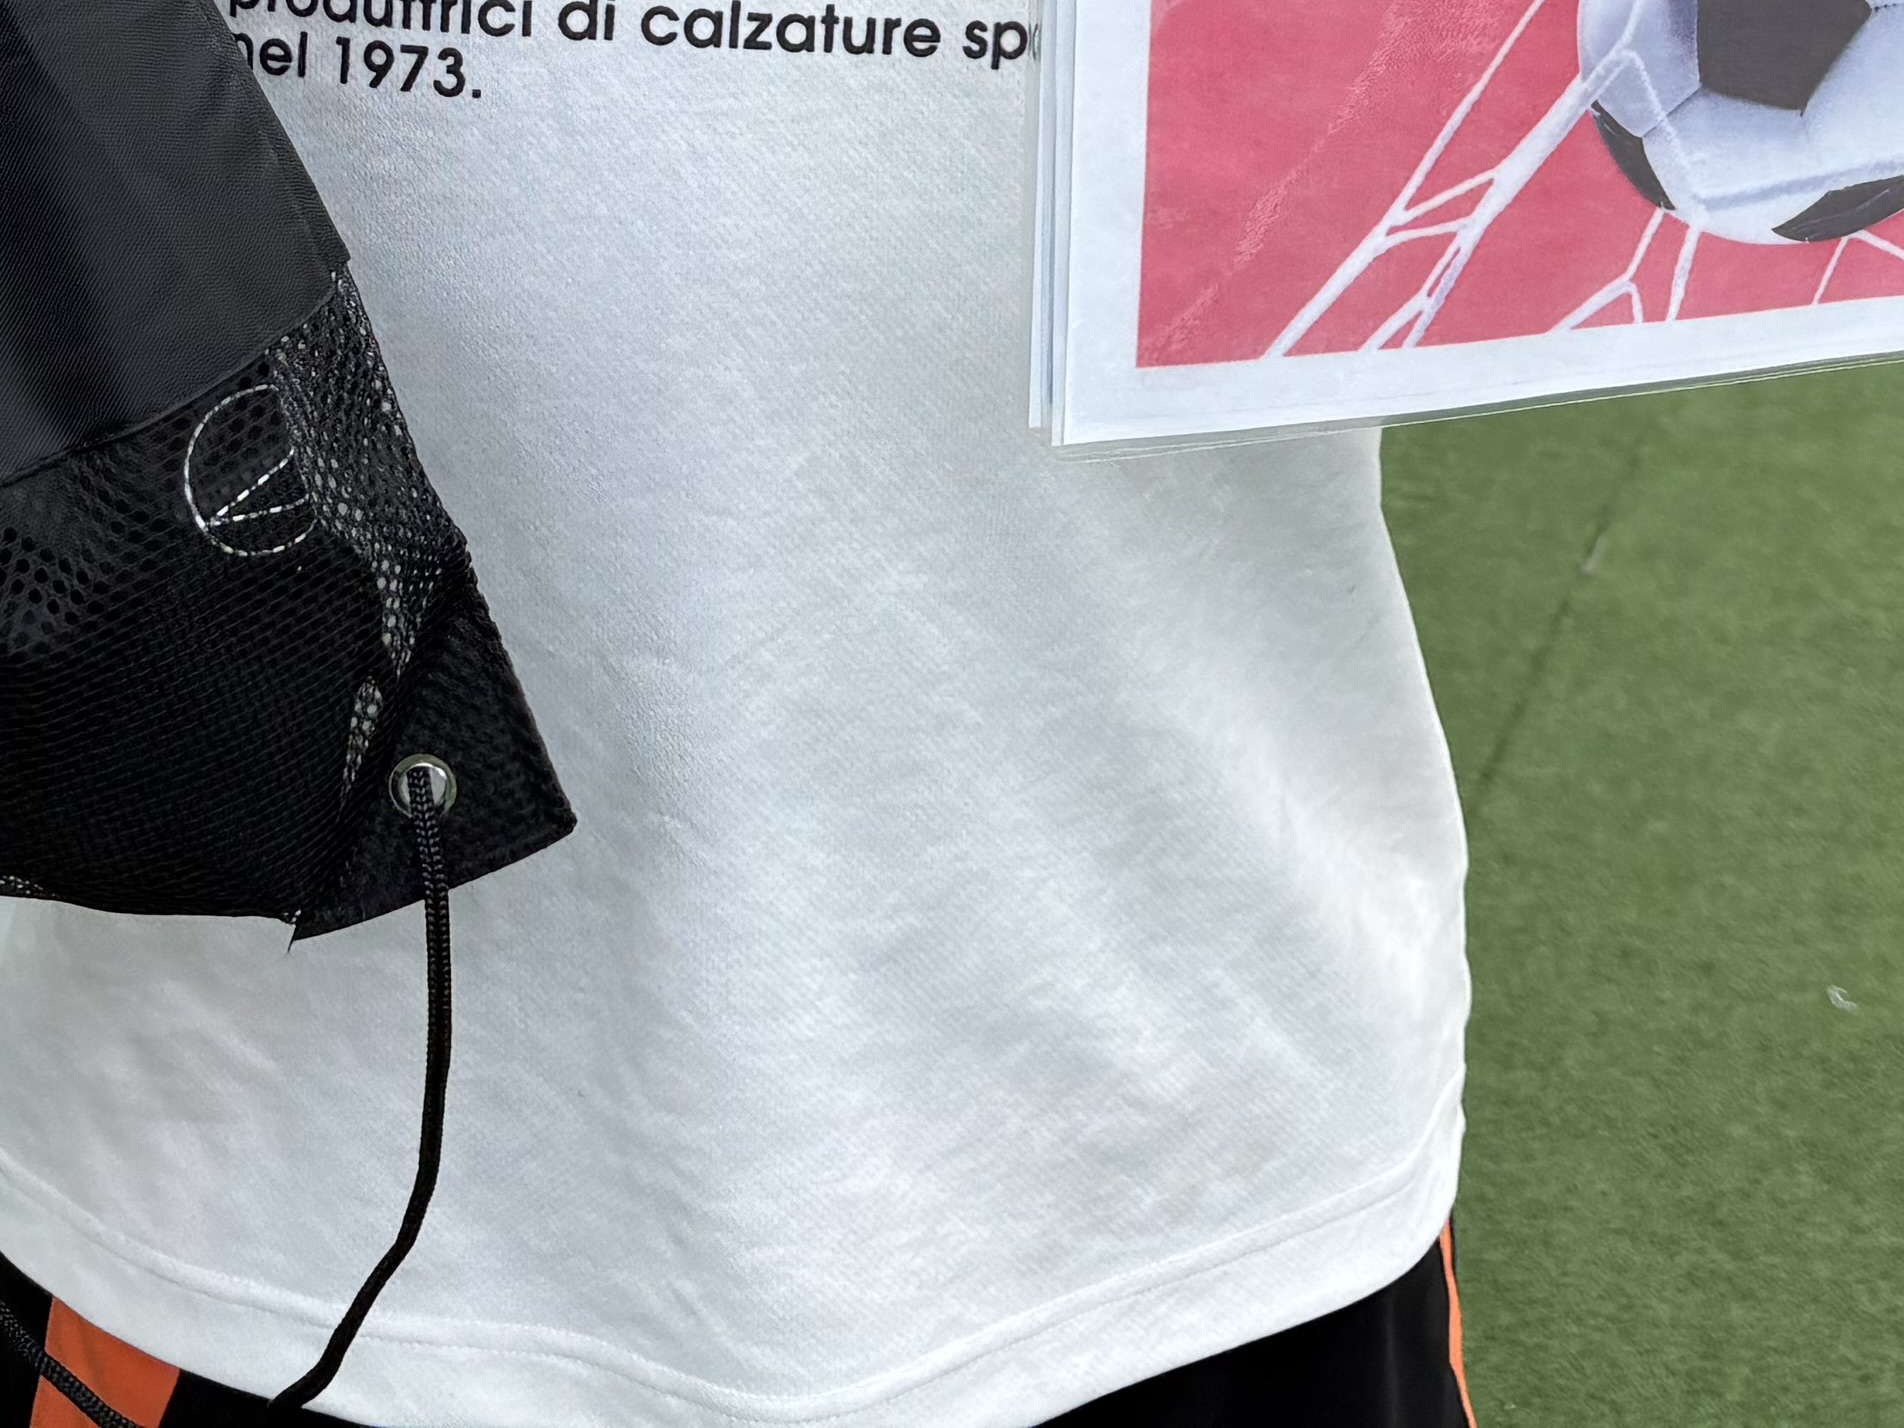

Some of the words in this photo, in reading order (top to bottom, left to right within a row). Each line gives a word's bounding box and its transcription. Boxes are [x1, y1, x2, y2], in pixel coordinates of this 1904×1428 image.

[336, 35, 482, 100] 1973.
[641, 0, 941, 57] calzature
[962, 19, 1041, 71] sp
